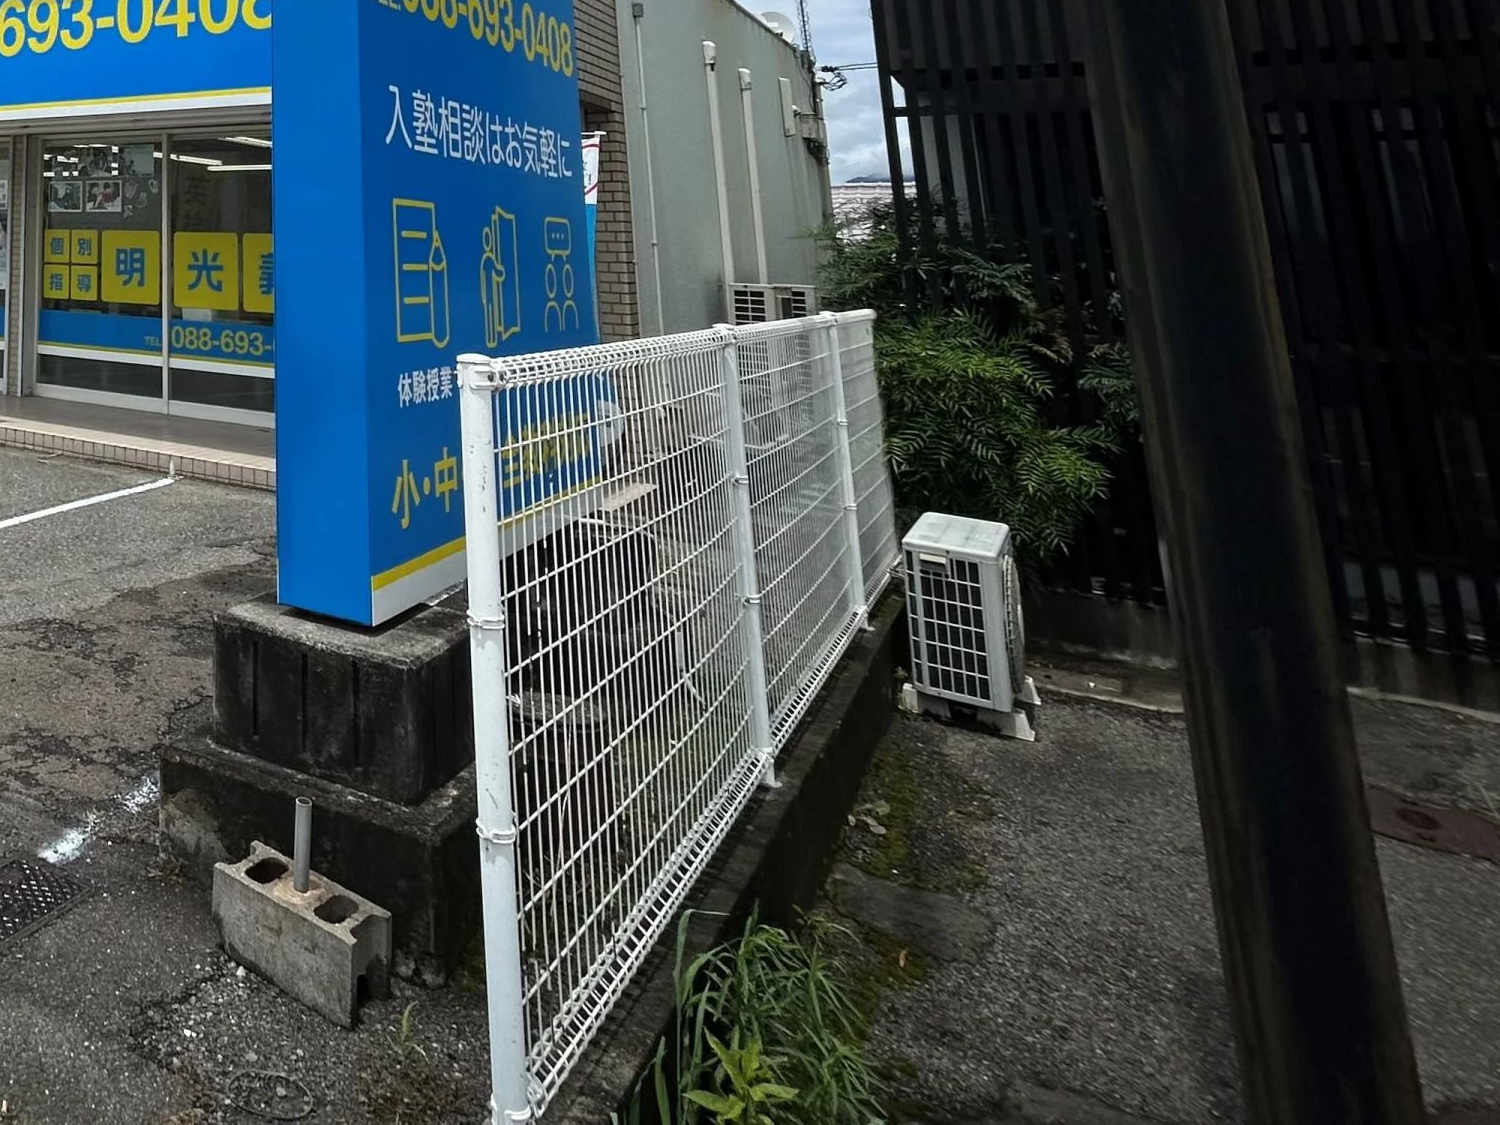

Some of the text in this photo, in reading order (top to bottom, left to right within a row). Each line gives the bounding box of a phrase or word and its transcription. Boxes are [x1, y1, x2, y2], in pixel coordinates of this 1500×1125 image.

[385, 85, 573, 179] 入塾相談はお気軽に
[50, 237, 92, 257] 個別
[49, 272, 92, 292] 指導
[171, 326, 275, 356] 088-693-
[397, 366, 458, 408] 体験授業
